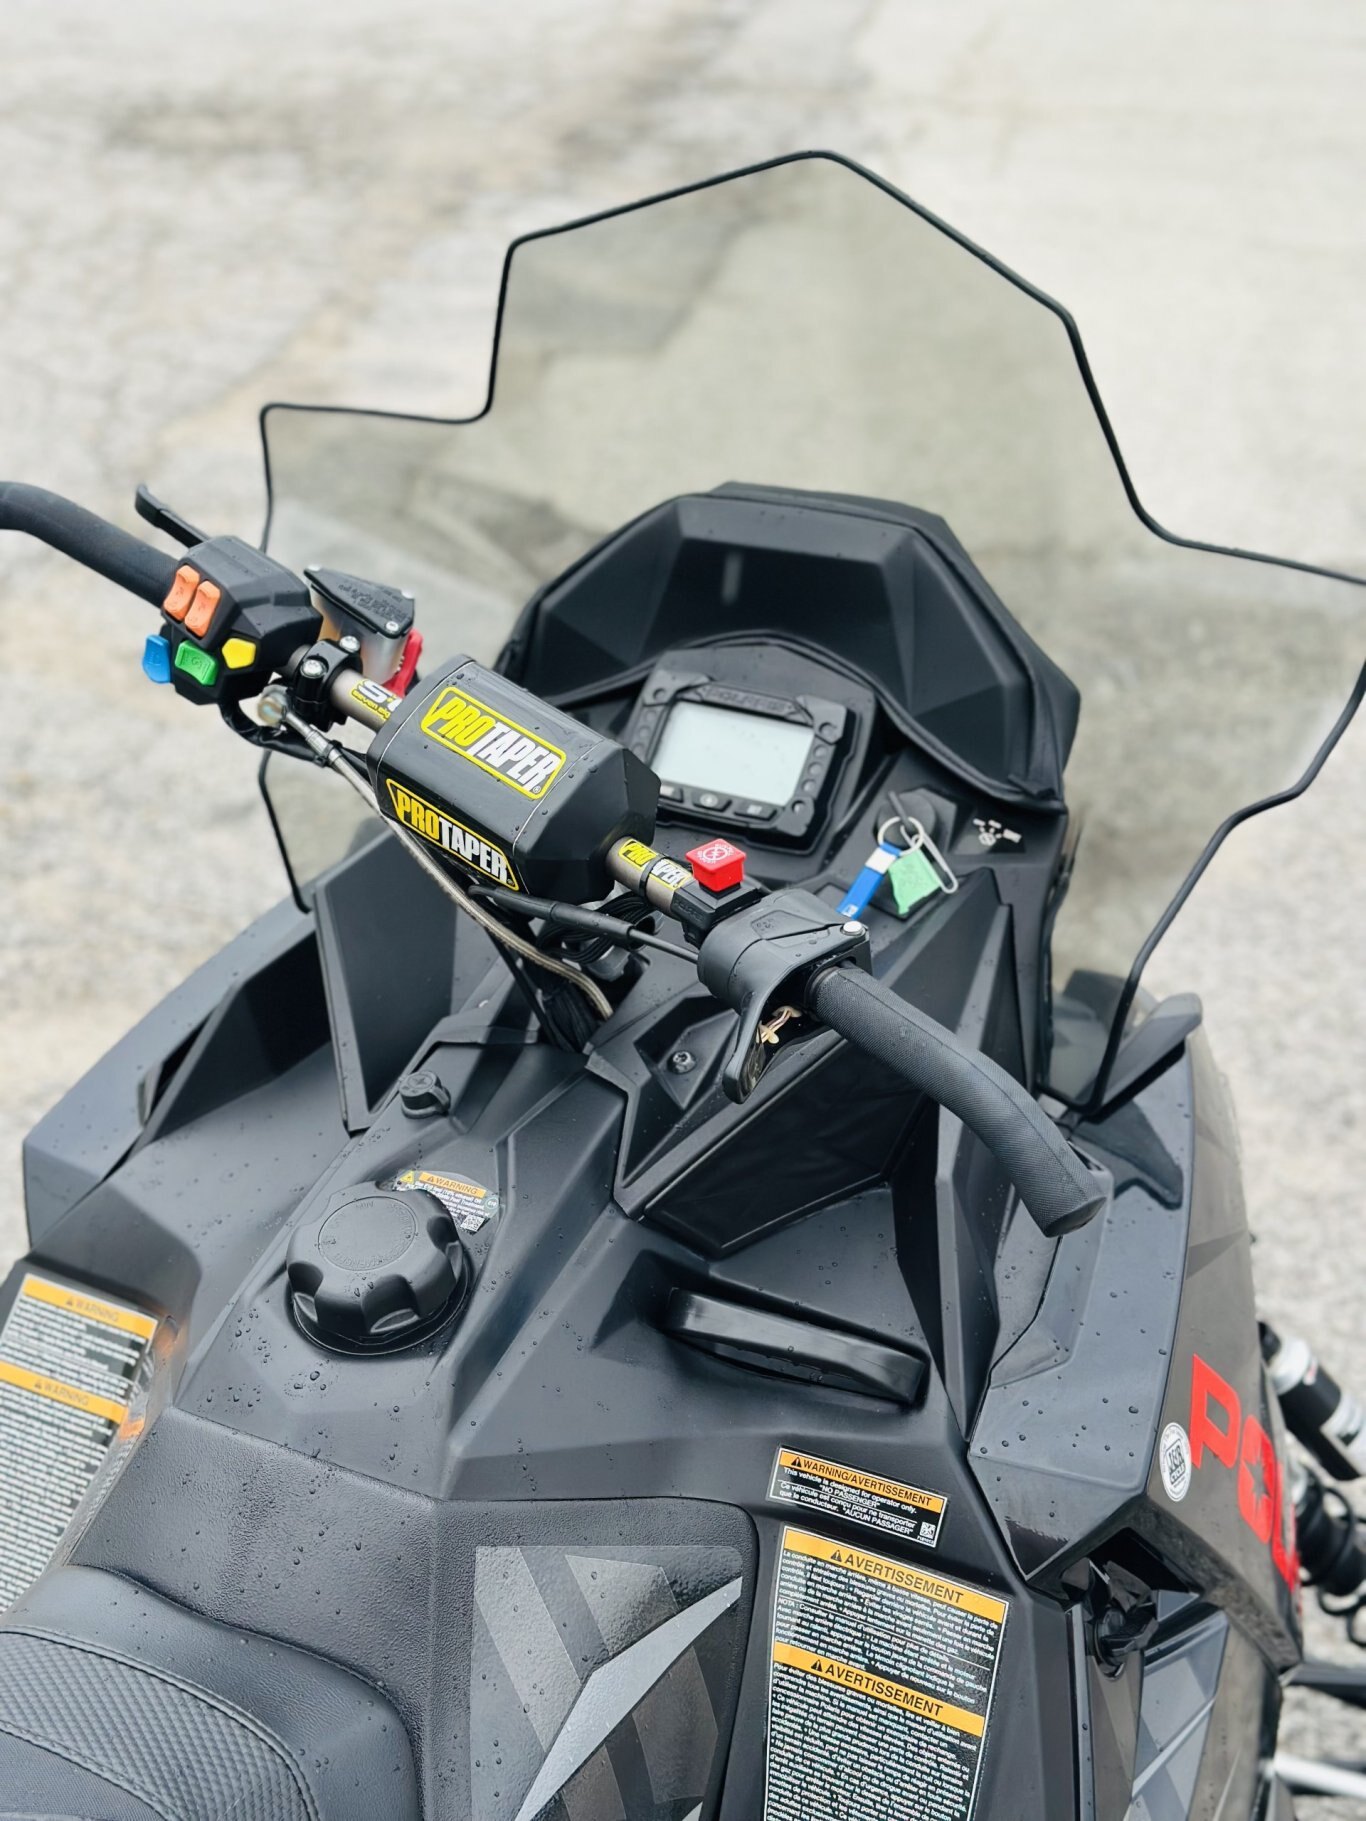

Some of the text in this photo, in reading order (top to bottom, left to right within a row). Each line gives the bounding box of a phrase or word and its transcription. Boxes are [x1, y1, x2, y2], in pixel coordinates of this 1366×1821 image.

[436, 1178, 478, 1195] WARNING
[802, 1459, 932, 1506] WARNING/AVERTISSEMENT
[844, 1553, 963, 1604] AVERTISSEMENT
[825, 1663, 942, 1717] AVERTISSEMENT
